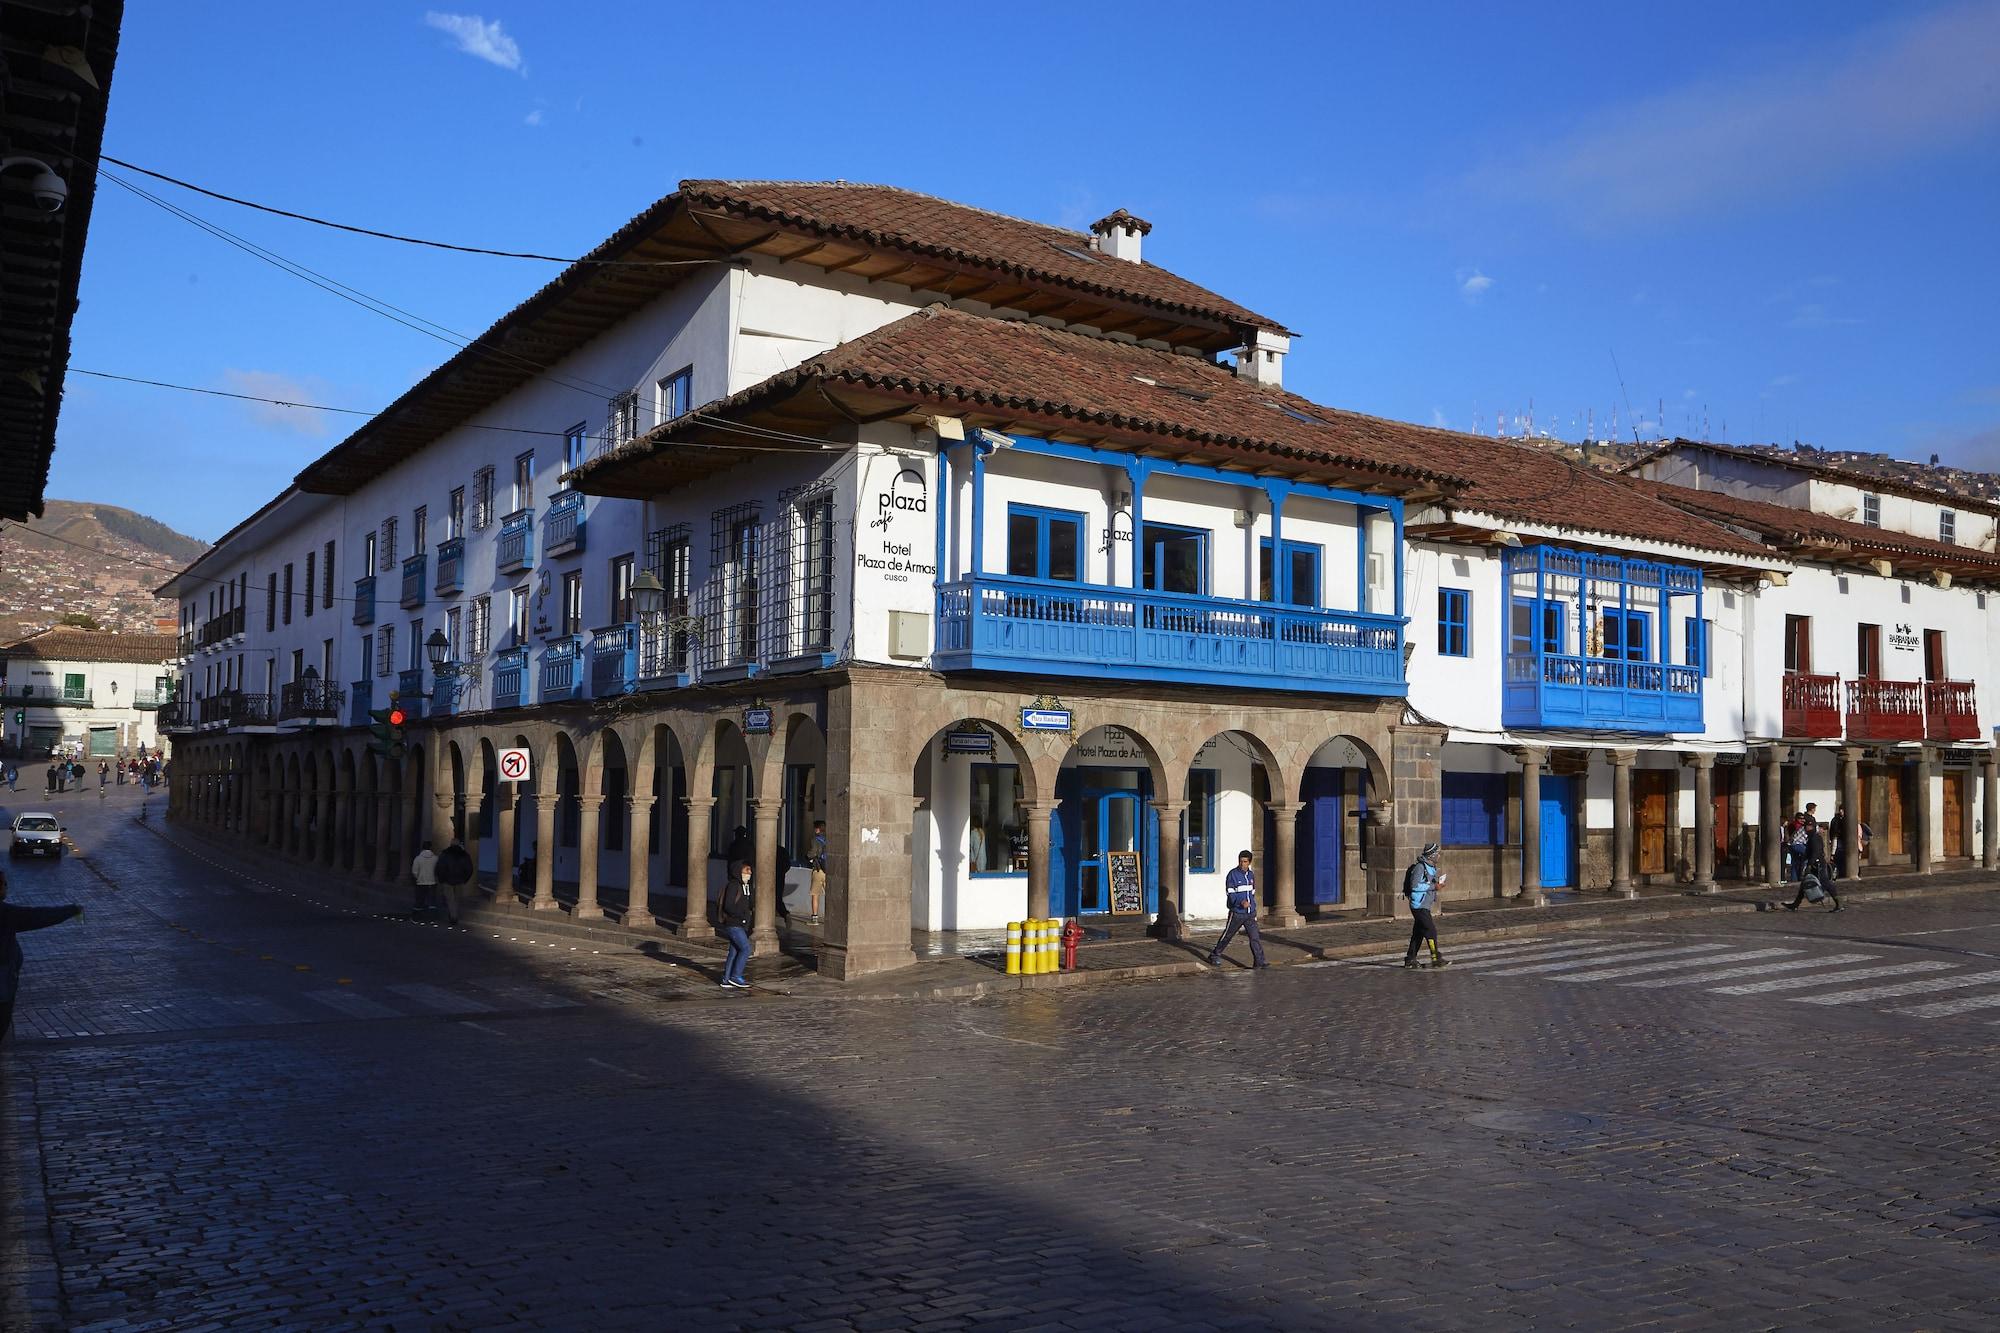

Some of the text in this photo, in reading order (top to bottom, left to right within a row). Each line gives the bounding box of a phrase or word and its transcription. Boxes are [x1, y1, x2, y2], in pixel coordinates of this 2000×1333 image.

[879, 490, 926, 515] plaza
[870, 510, 893, 533] café
[883, 540, 911, 556] Hotel
[857, 554, 936, 575] Plaza de Armas
[1077, 744, 1146, 758] Hotel Plaza de Arm
